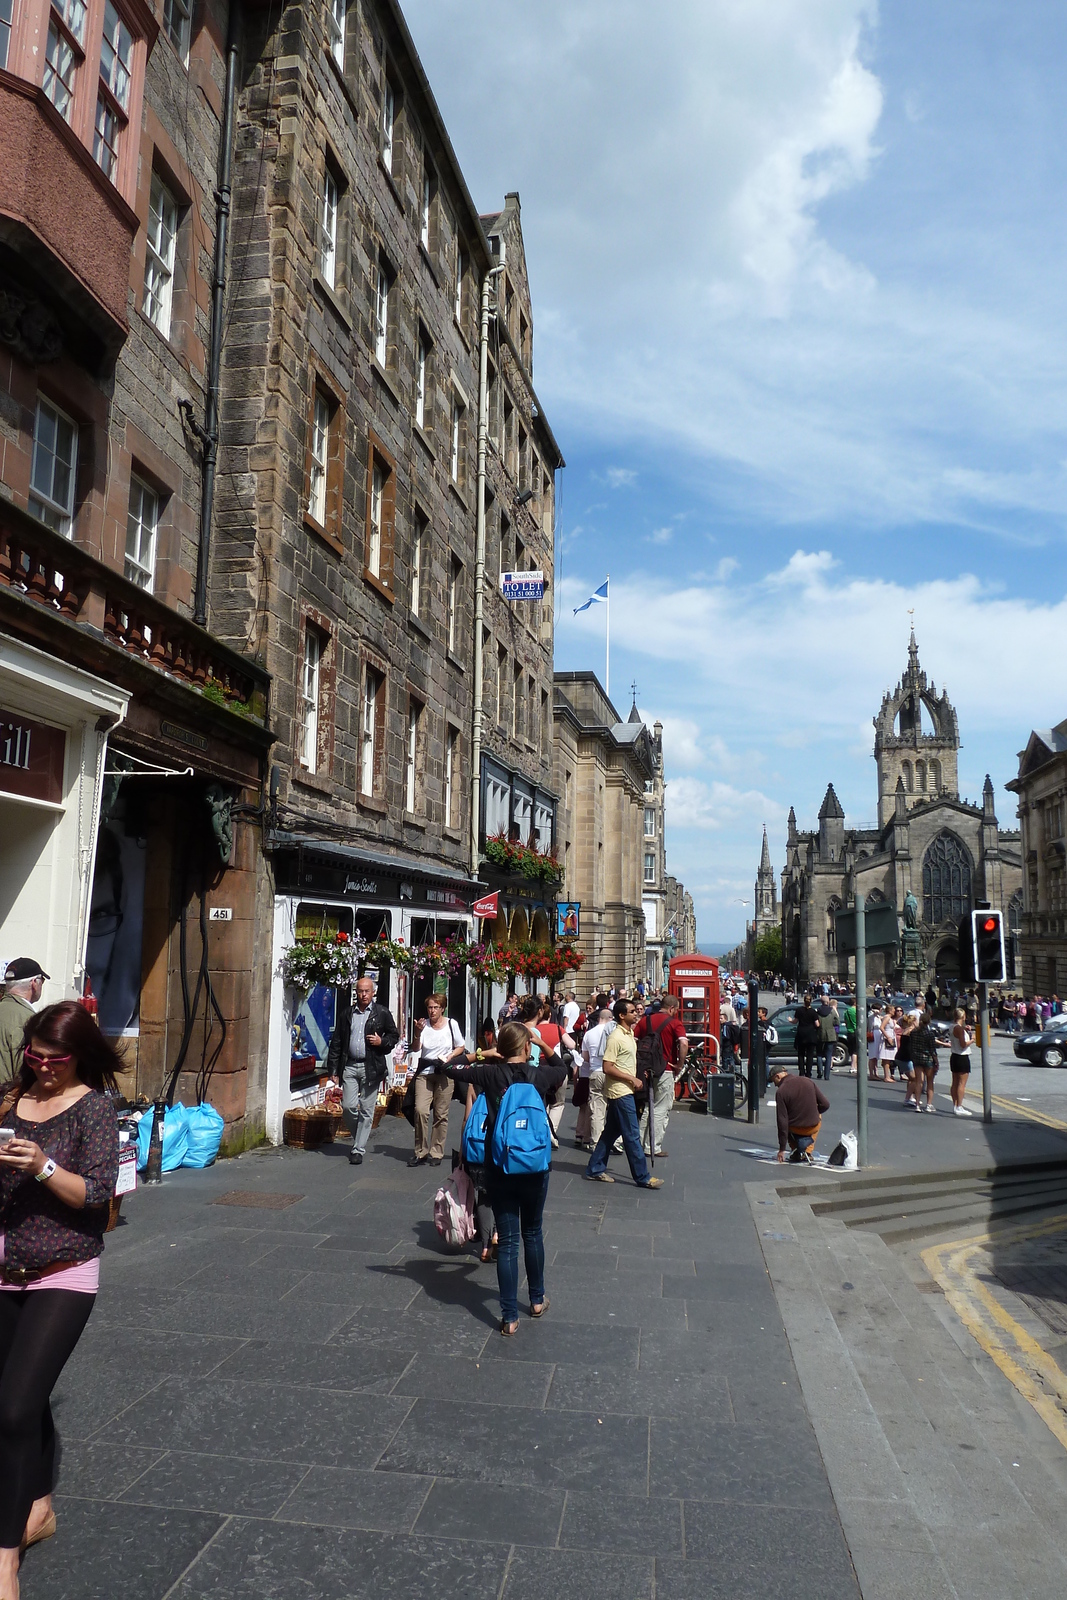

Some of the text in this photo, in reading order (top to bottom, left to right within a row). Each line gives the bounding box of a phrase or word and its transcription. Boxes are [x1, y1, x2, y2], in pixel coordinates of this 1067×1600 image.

[505, 582, 541, 591] TO LET
[0, 723, 32, 771] ill
[213, 909, 228, 919] 451
[515, 1119, 526, 1128] EF
[119, 1153, 135, 1163] PECIALS
